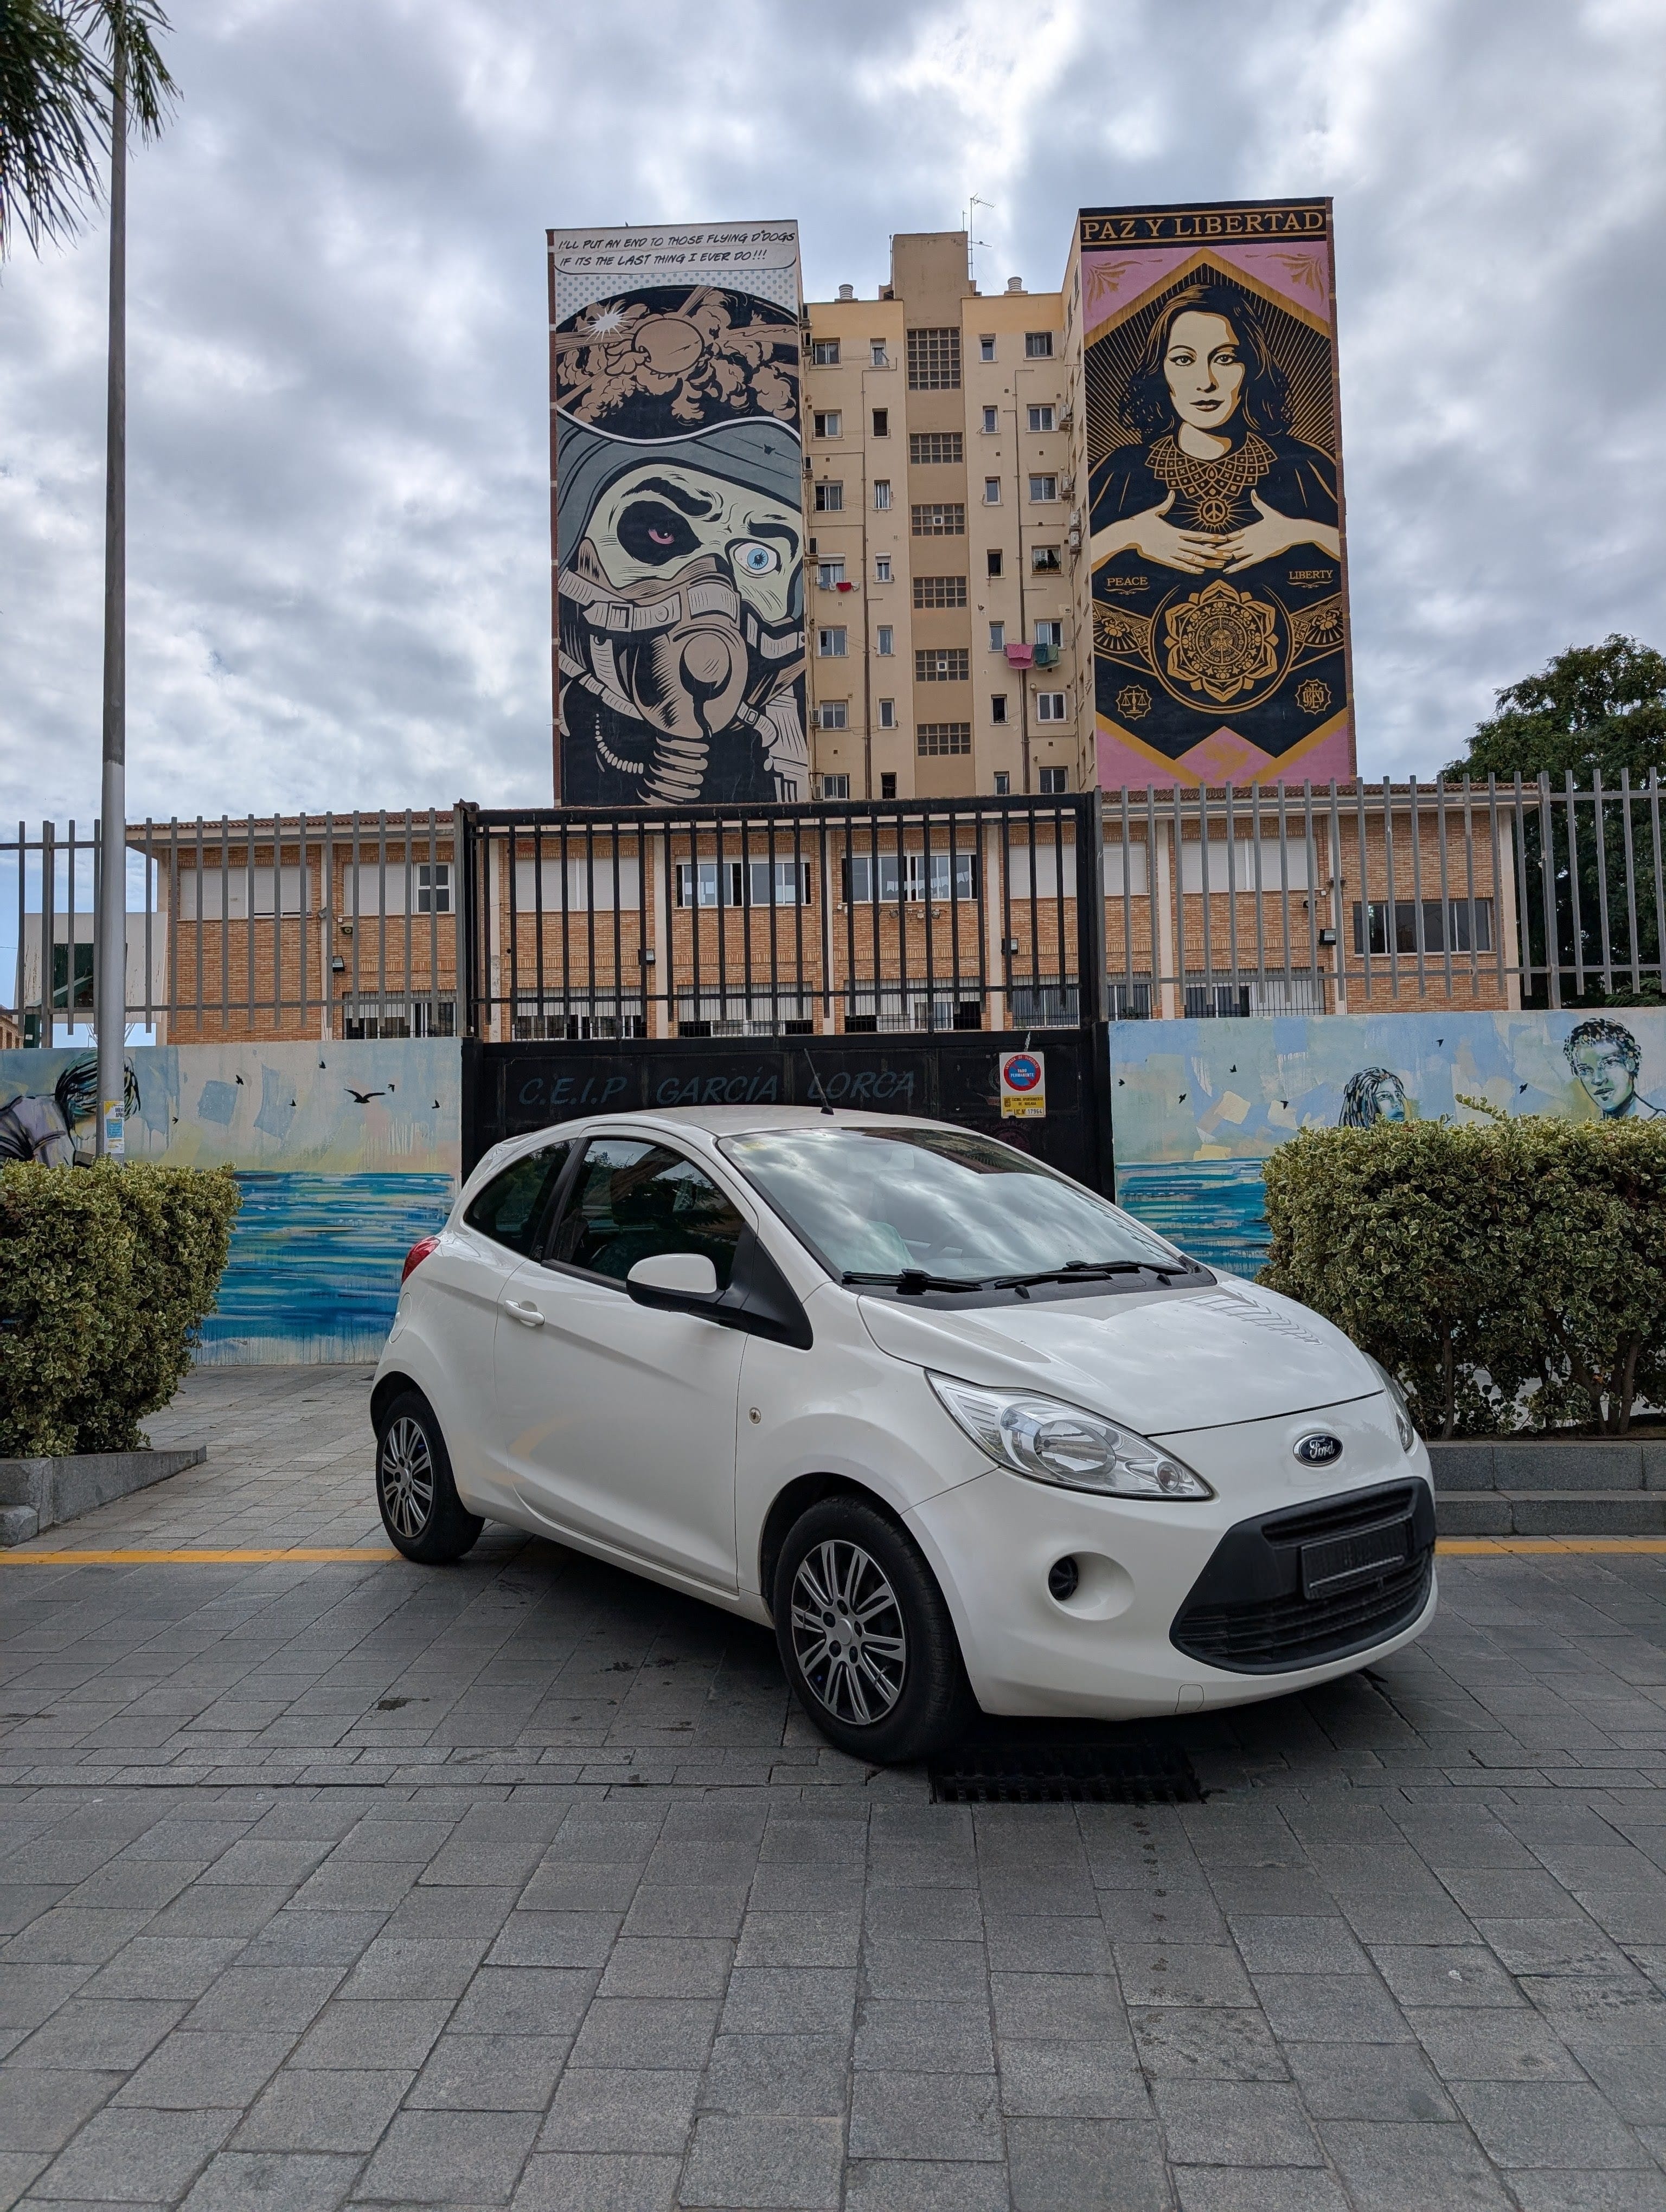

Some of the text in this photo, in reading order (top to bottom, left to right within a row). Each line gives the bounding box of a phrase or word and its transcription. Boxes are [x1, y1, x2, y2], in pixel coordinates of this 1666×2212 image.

[1083, 212, 1323, 240] PAZ Y LIBERTAD
[559, 241, 579, 249] I'LL
[583, 240, 604, 249] PUT
[605, 239, 621, 248] AN
[624, 237, 648, 247] END
[650, 237, 664, 246] TO
[668, 235, 704, 246] THOSE
[706, 233, 748, 244] FLYING
[560, 249, 767, 266] IF ITS THE LAST THING I EVER DO!!!
[1107, 577, 1148, 587] PEACE
[1289, 570, 1333, 580] LIBERTY
[656, 1066, 778, 1105] GARCÍA
[807, 1070, 914, 1100] LORCA
[1309, 1438, 1335, 1459] Ford
